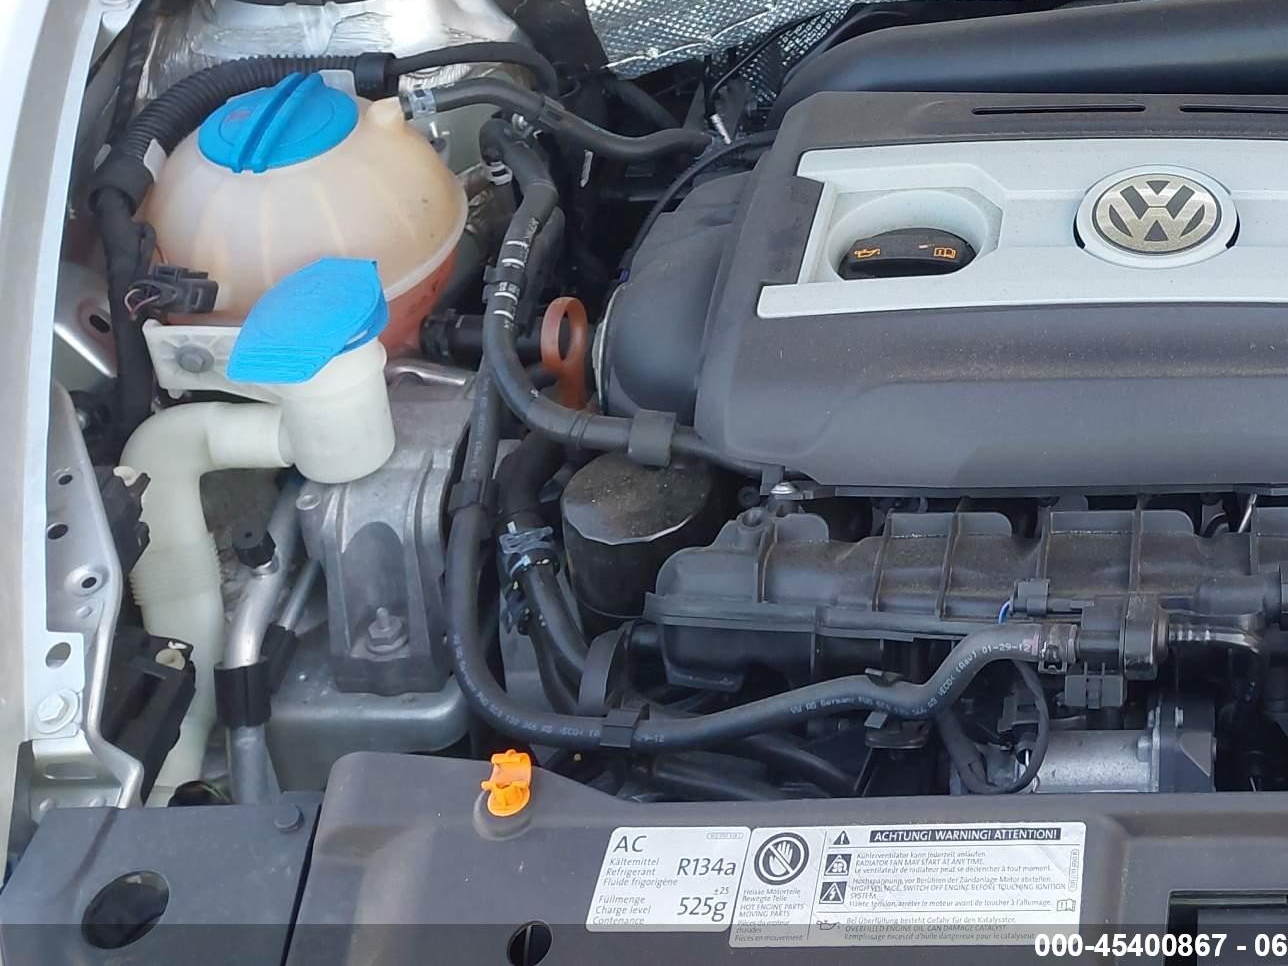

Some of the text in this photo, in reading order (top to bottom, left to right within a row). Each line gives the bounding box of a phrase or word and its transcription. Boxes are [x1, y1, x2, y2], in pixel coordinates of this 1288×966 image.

[874, 829, 1057, 842] ACHTUNG! WARNING! ATTENTION!
[613, 835, 647, 853] AC
[609, 857, 660, 867] Kältemittel
[677, 858, 737, 876] R134a
[922, 858, 941, 866] START
[606, 867, 655, 878] Refrigerant
[603, 878, 629, 886] Fluide
[947, 876, 958, 884] der
[599, 895, 646, 906] Füllmenge
[595, 905, 652, 917] Charge level
[677, 896, 728, 922] 525g
[592, 916, 645, 926] Contenance
